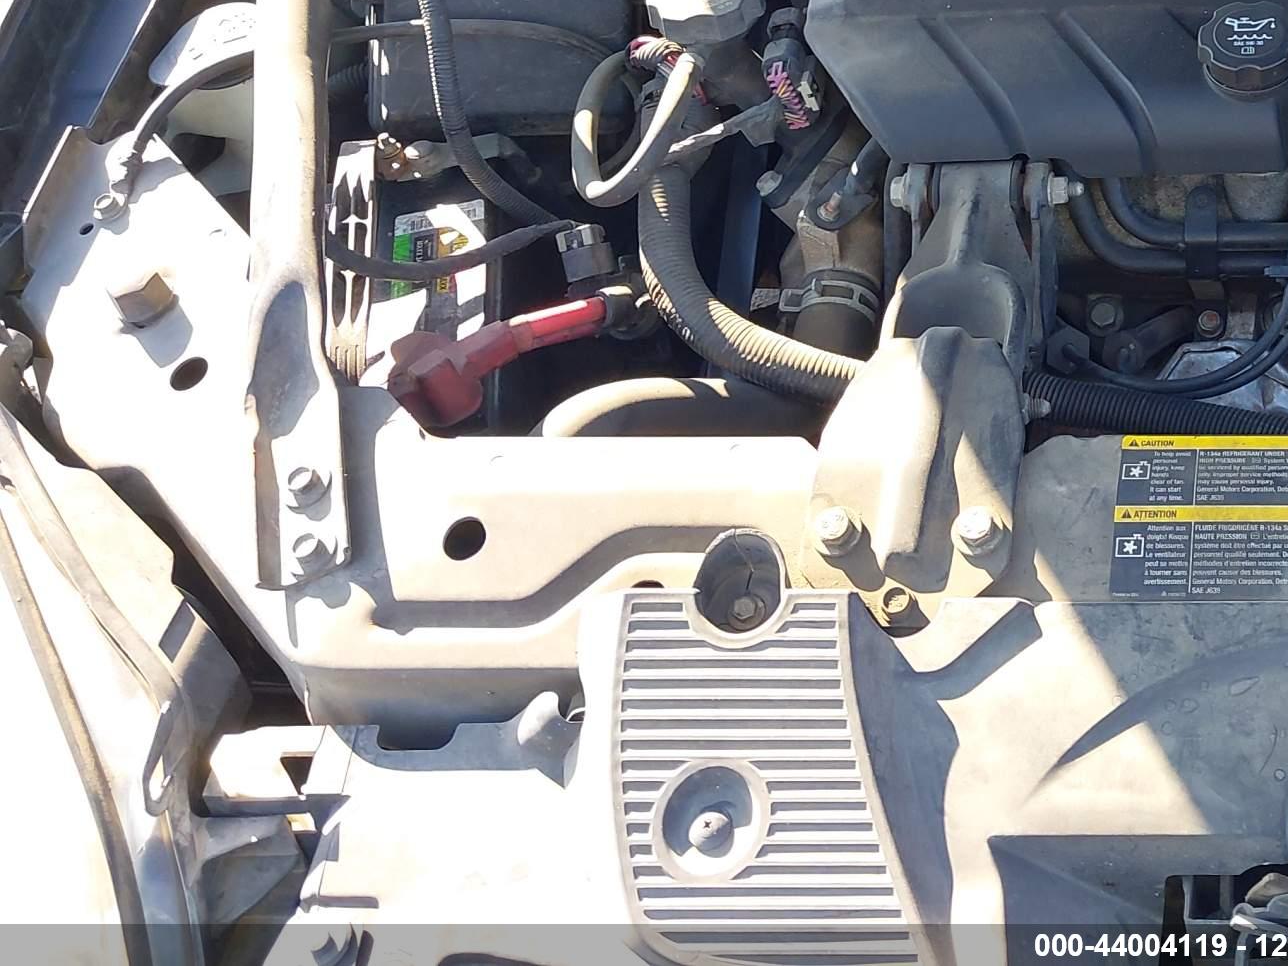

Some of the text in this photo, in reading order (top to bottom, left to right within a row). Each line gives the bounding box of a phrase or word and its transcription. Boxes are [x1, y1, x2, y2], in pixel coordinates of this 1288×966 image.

[1133, 510, 1177, 518] ATTENTION
[1192, 578, 1215, 586] General
[1216, 578, 1237, 586] Motors
